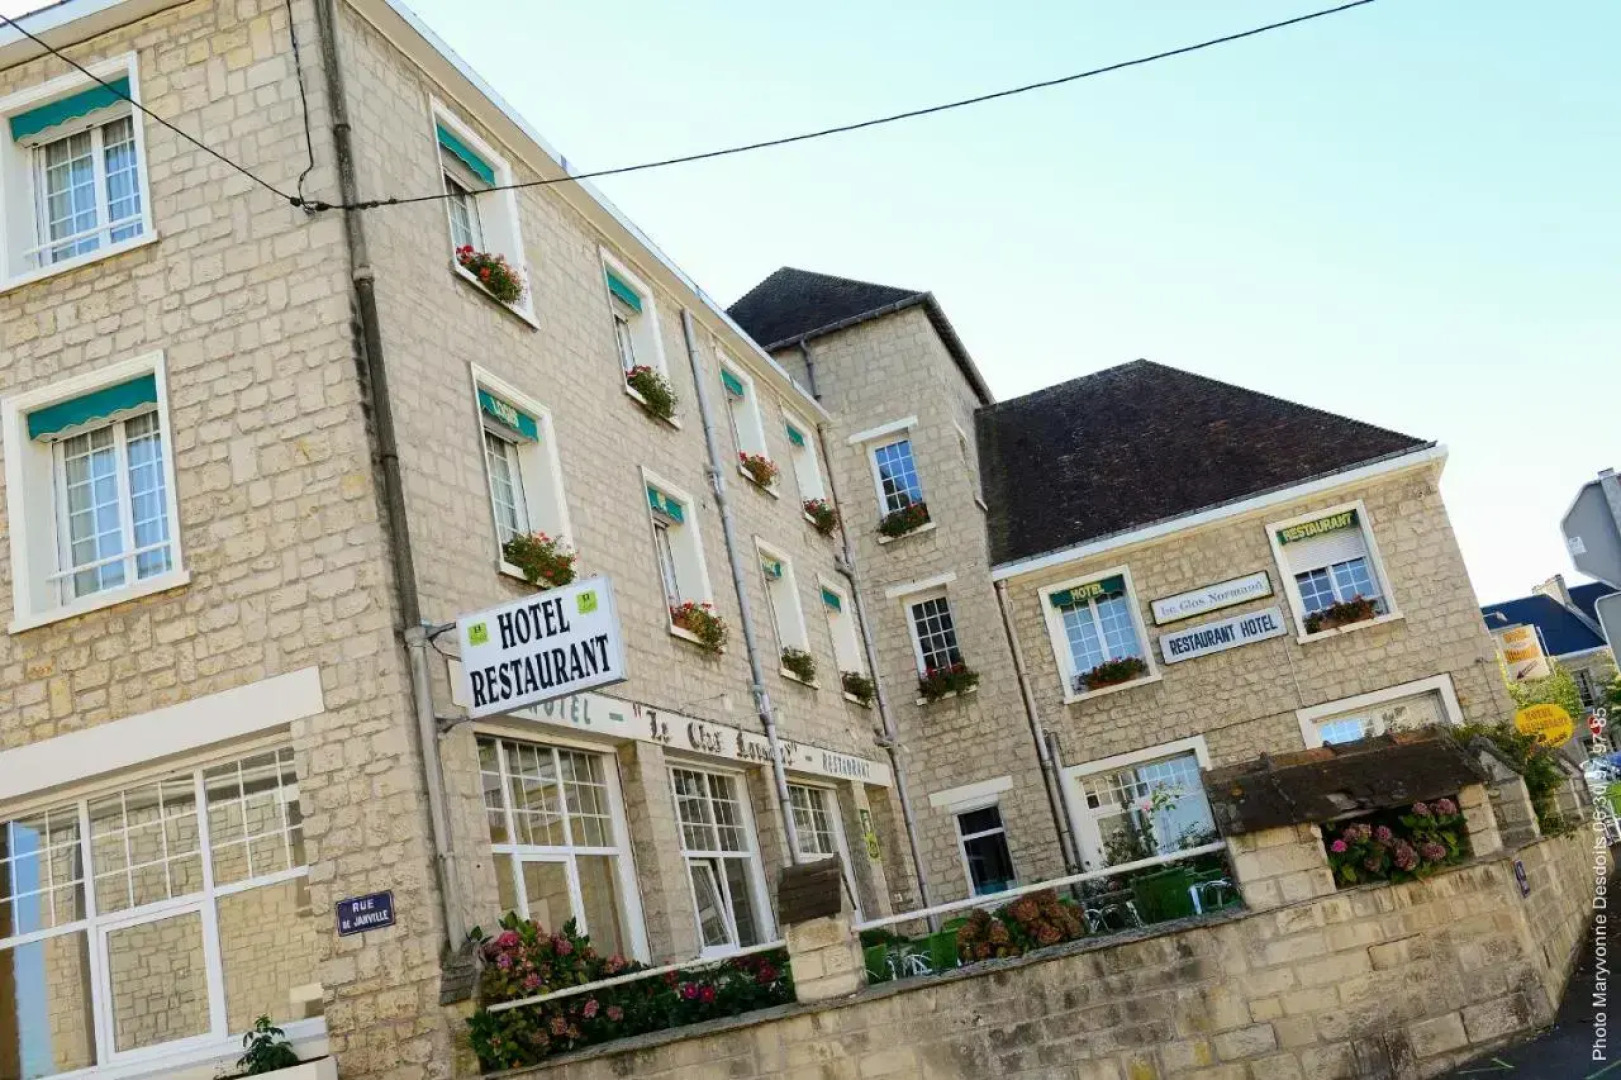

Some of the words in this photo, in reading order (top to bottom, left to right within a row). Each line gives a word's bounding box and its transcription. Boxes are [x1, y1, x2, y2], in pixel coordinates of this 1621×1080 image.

[1282, 512, 1351, 541] RESTAURANT
[1070, 583, 1105, 600] HOTEL
[1180, 598, 1206, 611] Clos
[1207, 580, 1264, 604] Normand
[497, 597, 570, 650] HOTEL
[1168, 624, 1236, 656] RESTAURANT
[1240, 613, 1278, 638] HOTEL
[469, 633, 611, 708] RESTAURANT
[352, 898, 375, 913] RUE
[353, 909, 389, 927] JANVILLE
